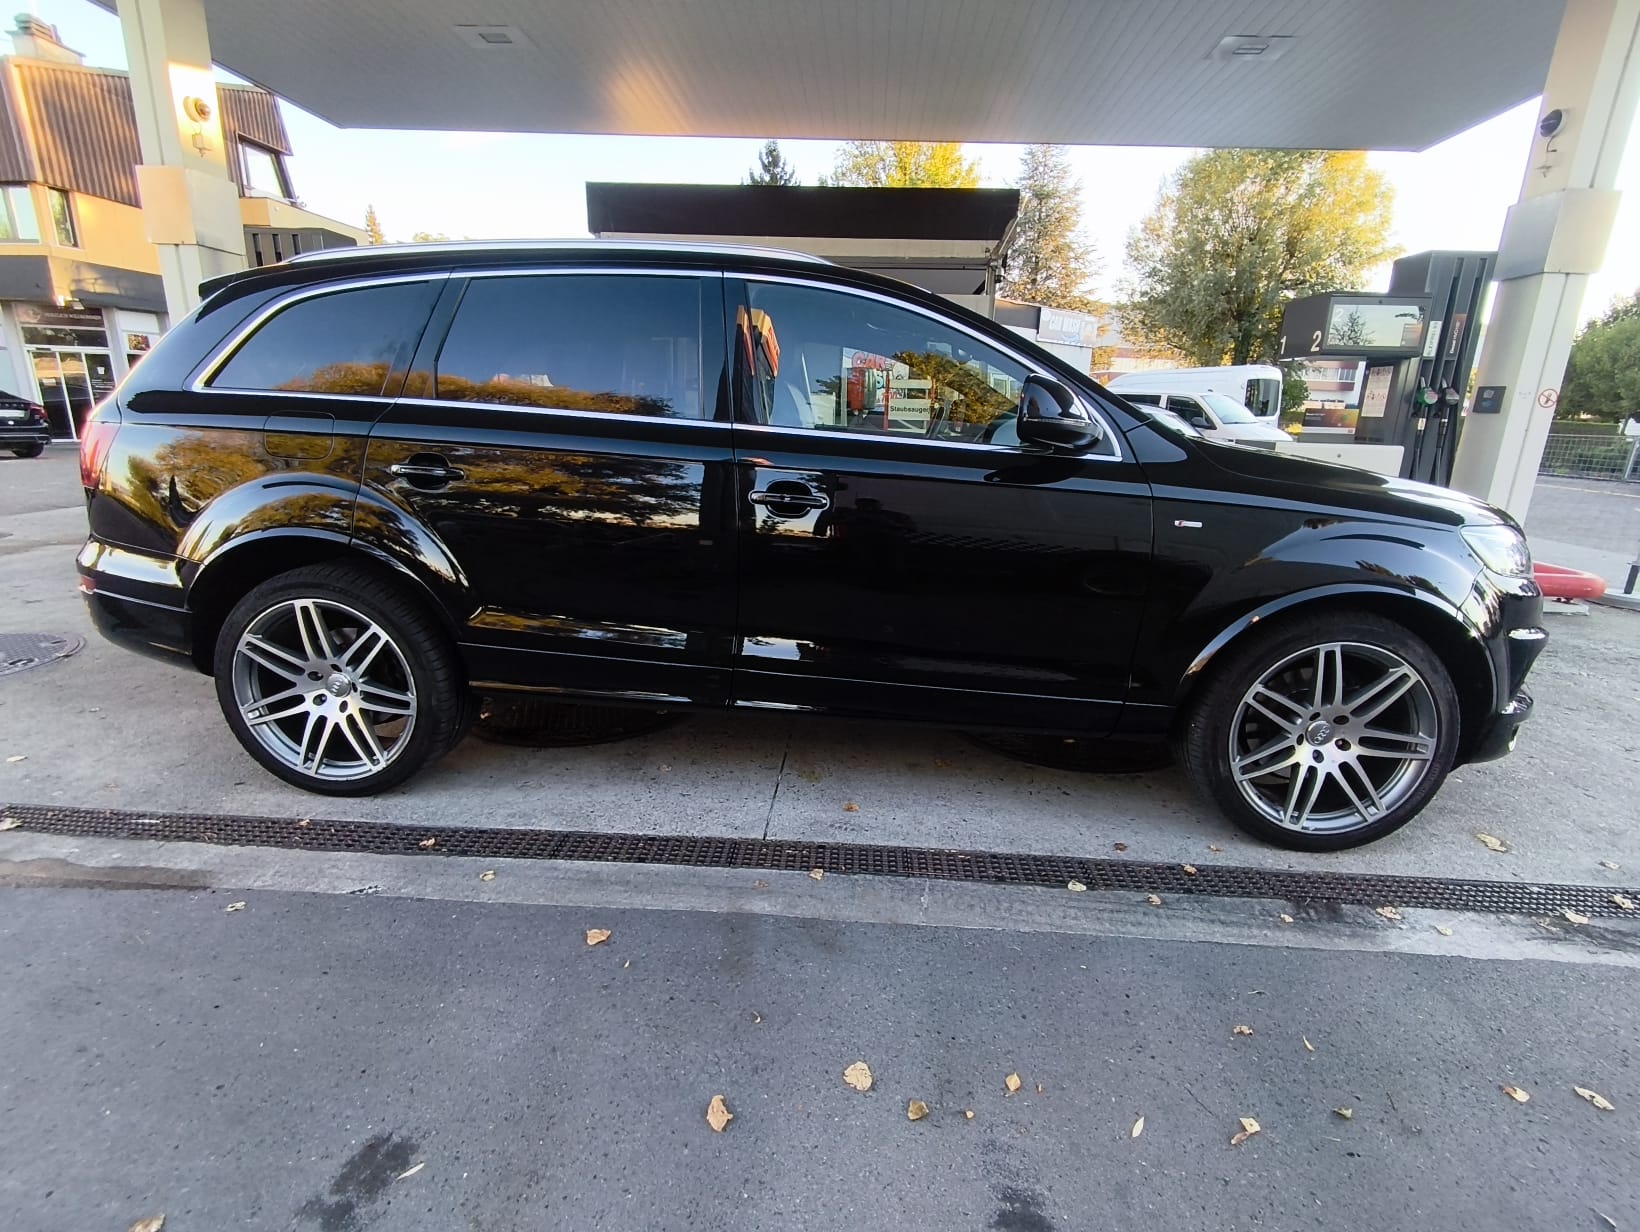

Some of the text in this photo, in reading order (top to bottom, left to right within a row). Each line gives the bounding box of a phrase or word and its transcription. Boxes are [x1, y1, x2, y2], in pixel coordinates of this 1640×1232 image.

[1280, 335, 1287, 355] 1
[1310, 330, 1322, 352] 2
[890, 405, 930, 414] Staubsauger
